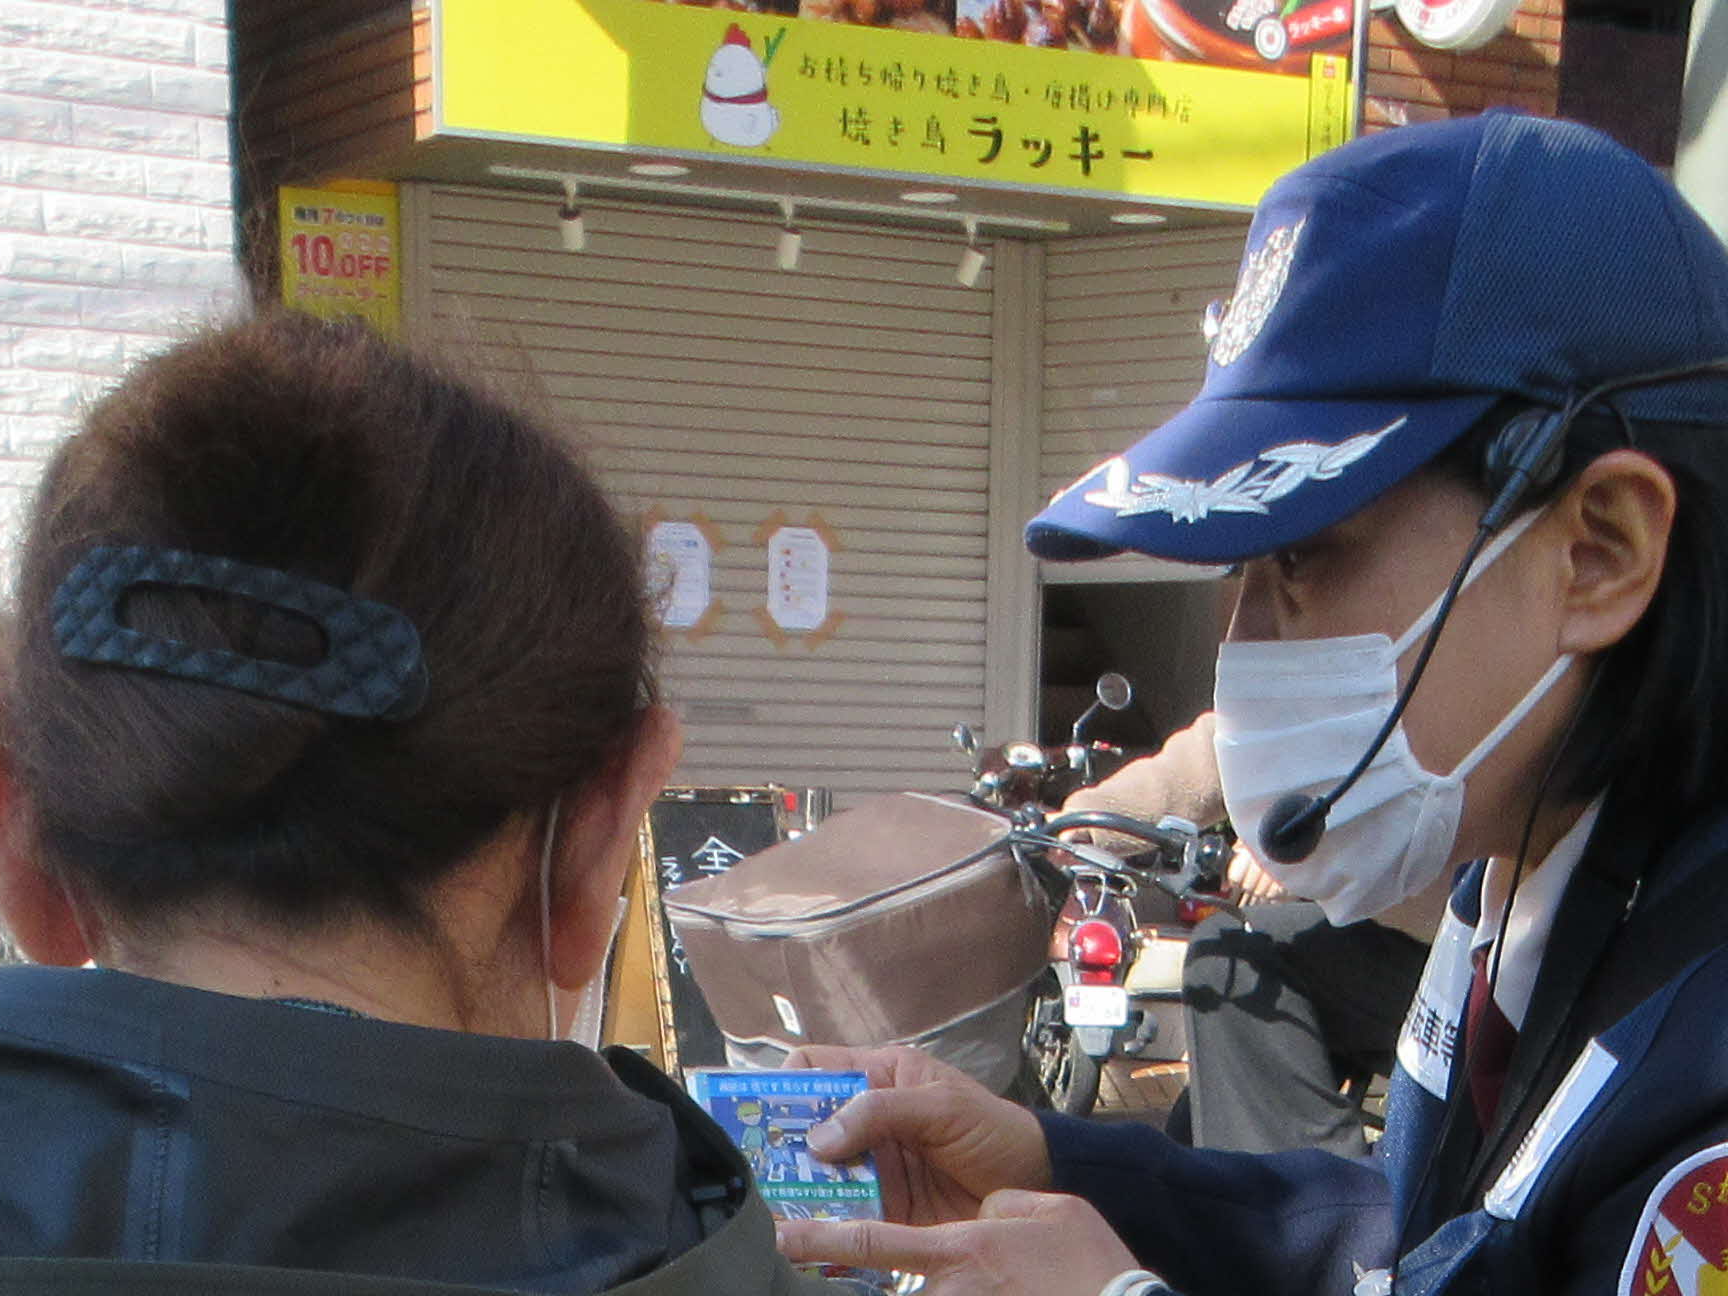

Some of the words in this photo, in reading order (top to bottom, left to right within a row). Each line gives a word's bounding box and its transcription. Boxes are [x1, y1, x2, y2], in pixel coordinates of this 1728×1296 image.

[840, 105, 948, 155] 焼き鳥
[968, 116, 1154, 177] ラッキー
